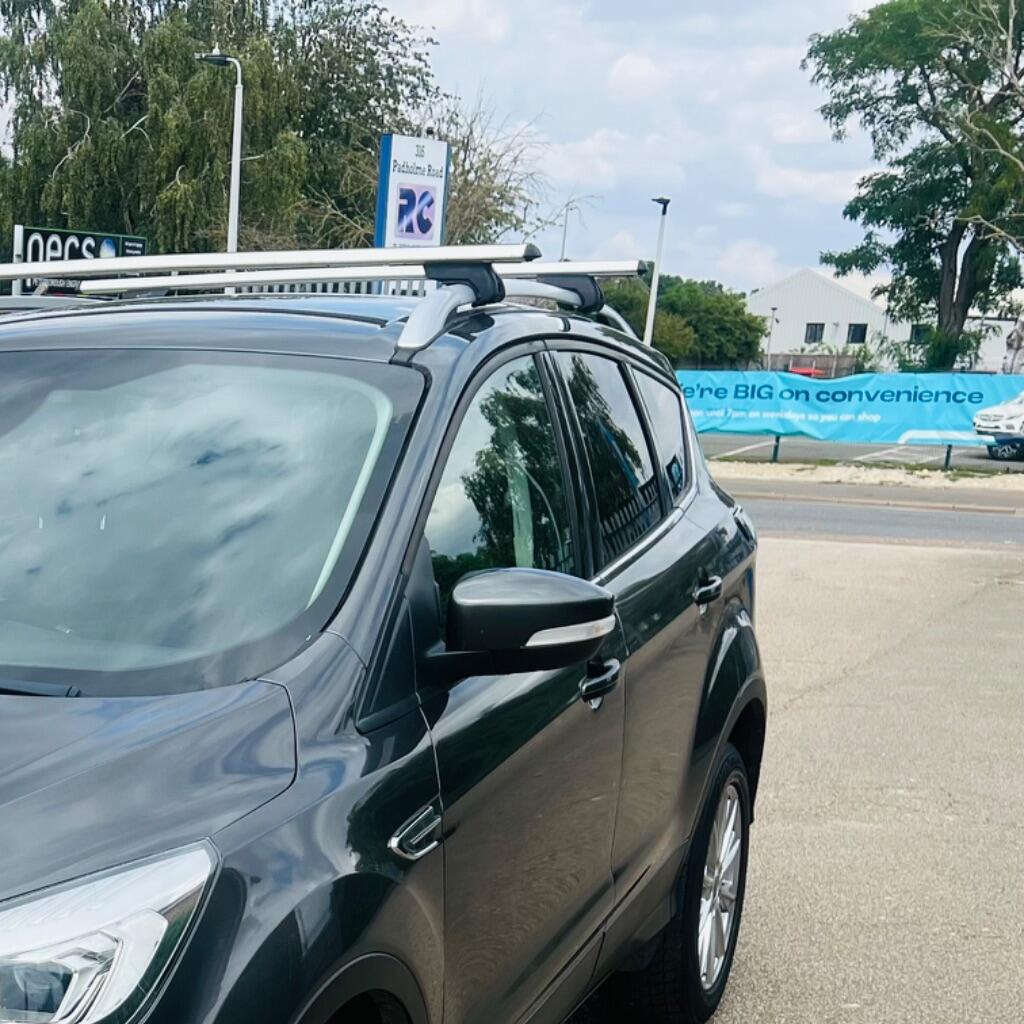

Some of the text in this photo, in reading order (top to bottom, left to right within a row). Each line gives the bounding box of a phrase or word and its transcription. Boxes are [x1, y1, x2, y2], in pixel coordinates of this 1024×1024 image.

[392, 159, 444, 179] Padholme Road
[681, 384, 984, 404] e're BIG on convenience
[819, 414, 838, 423] you
[857, 411, 881, 423] shop
